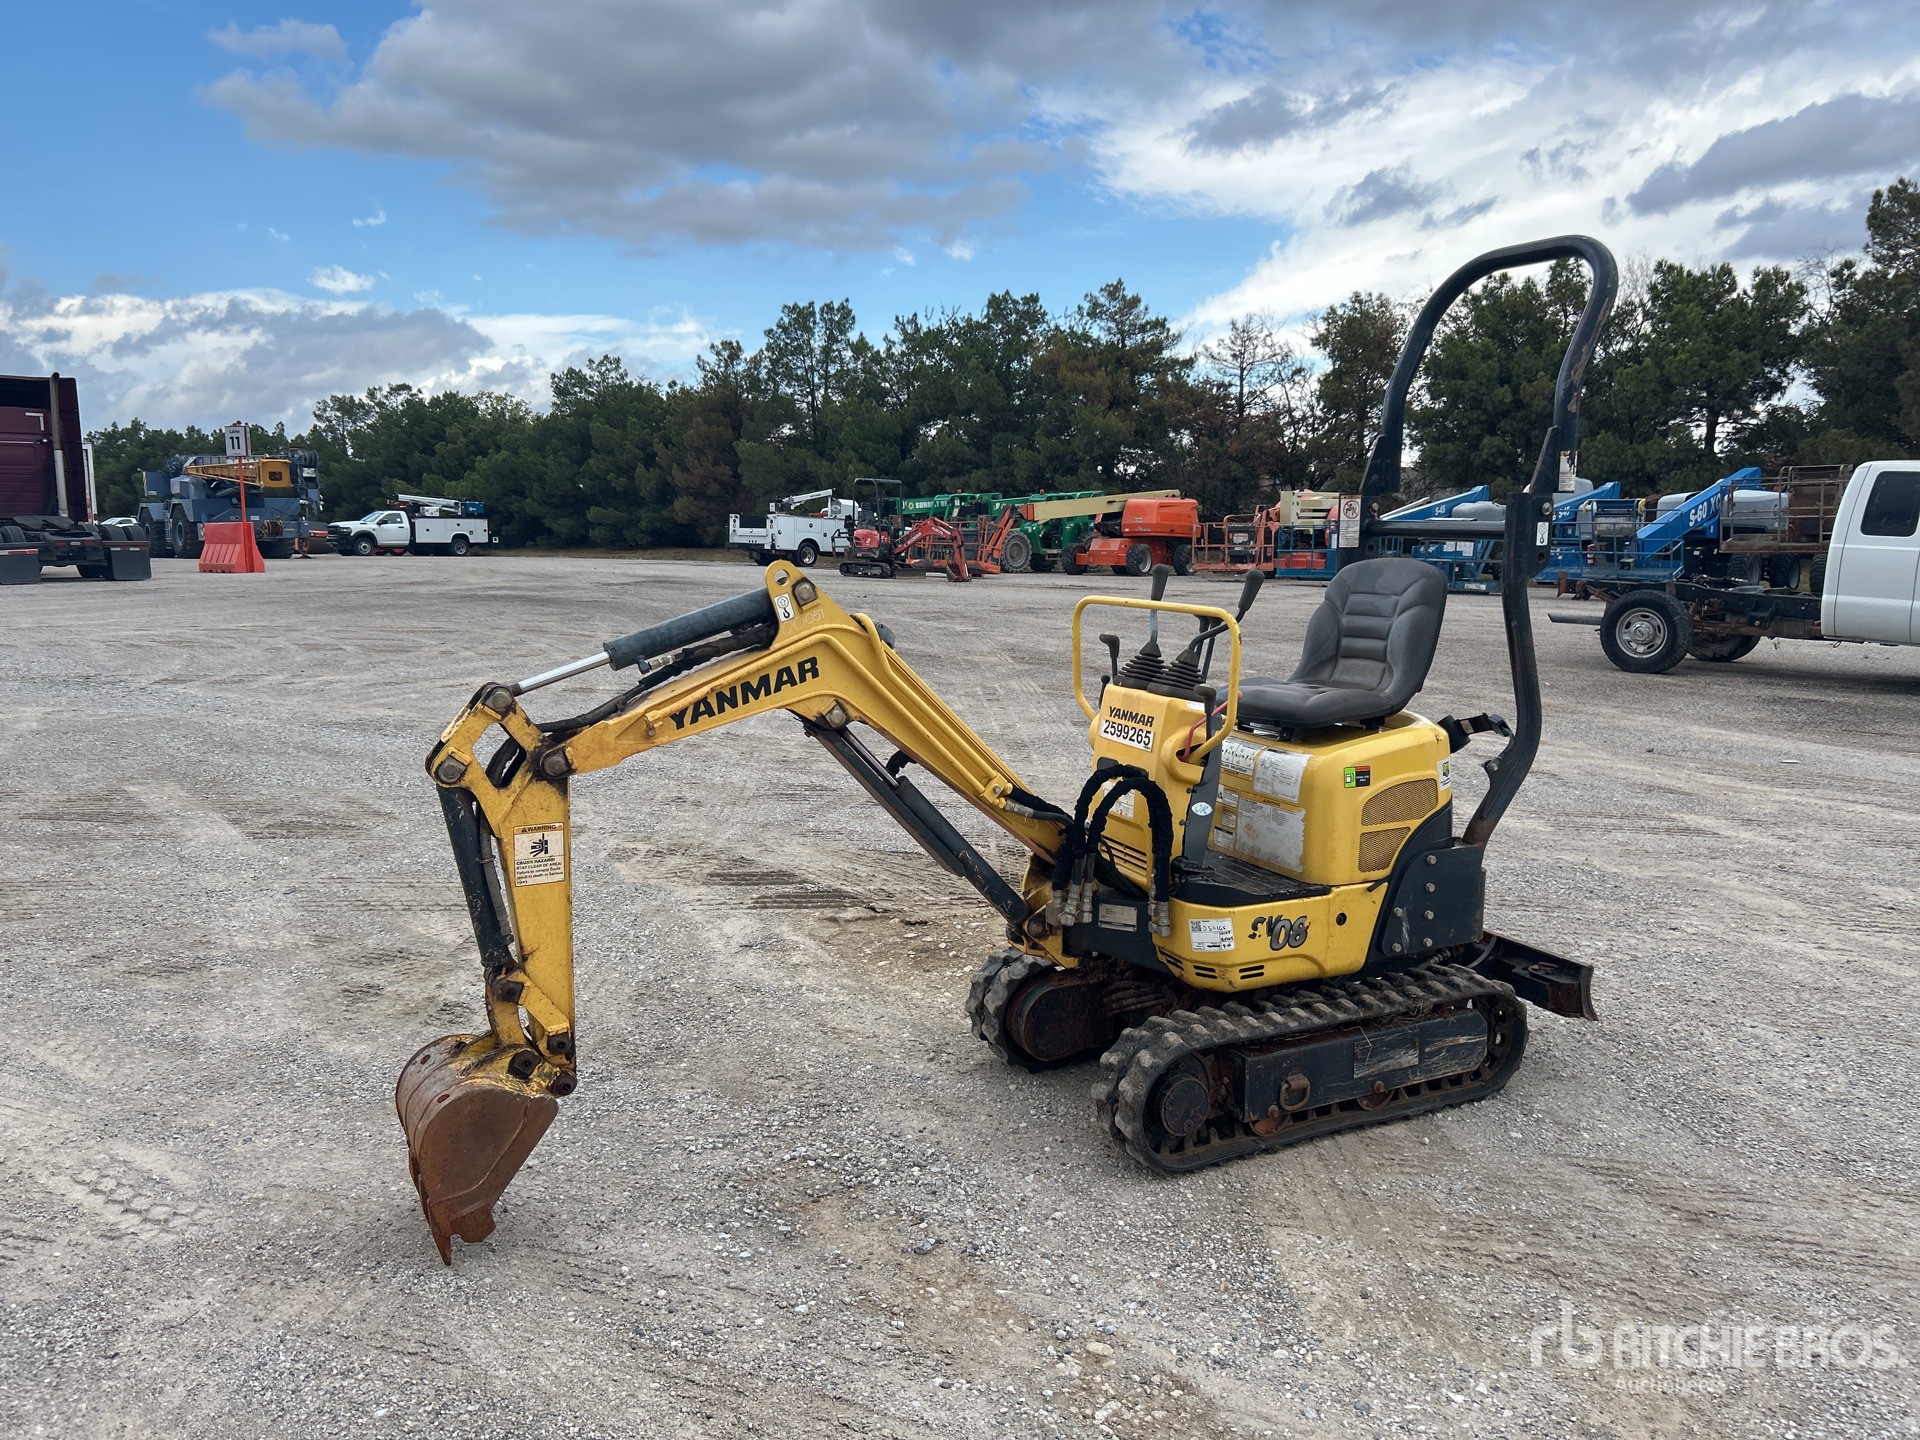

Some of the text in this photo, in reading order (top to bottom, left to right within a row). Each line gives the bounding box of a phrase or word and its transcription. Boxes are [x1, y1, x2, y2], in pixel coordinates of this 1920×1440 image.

[229, 436, 241, 450] 11
[1434, 505, 1446, 516] S-45
[1688, 501, 1707, 527] S-60
[669, 656, 820, 730] YANMAR
[1109, 705, 1155, 728] YANMAR
[1103, 719, 1152, 747] 2599265
[1195, 804, 1209, 814] OK
[527, 824, 557, 832] WARNING
